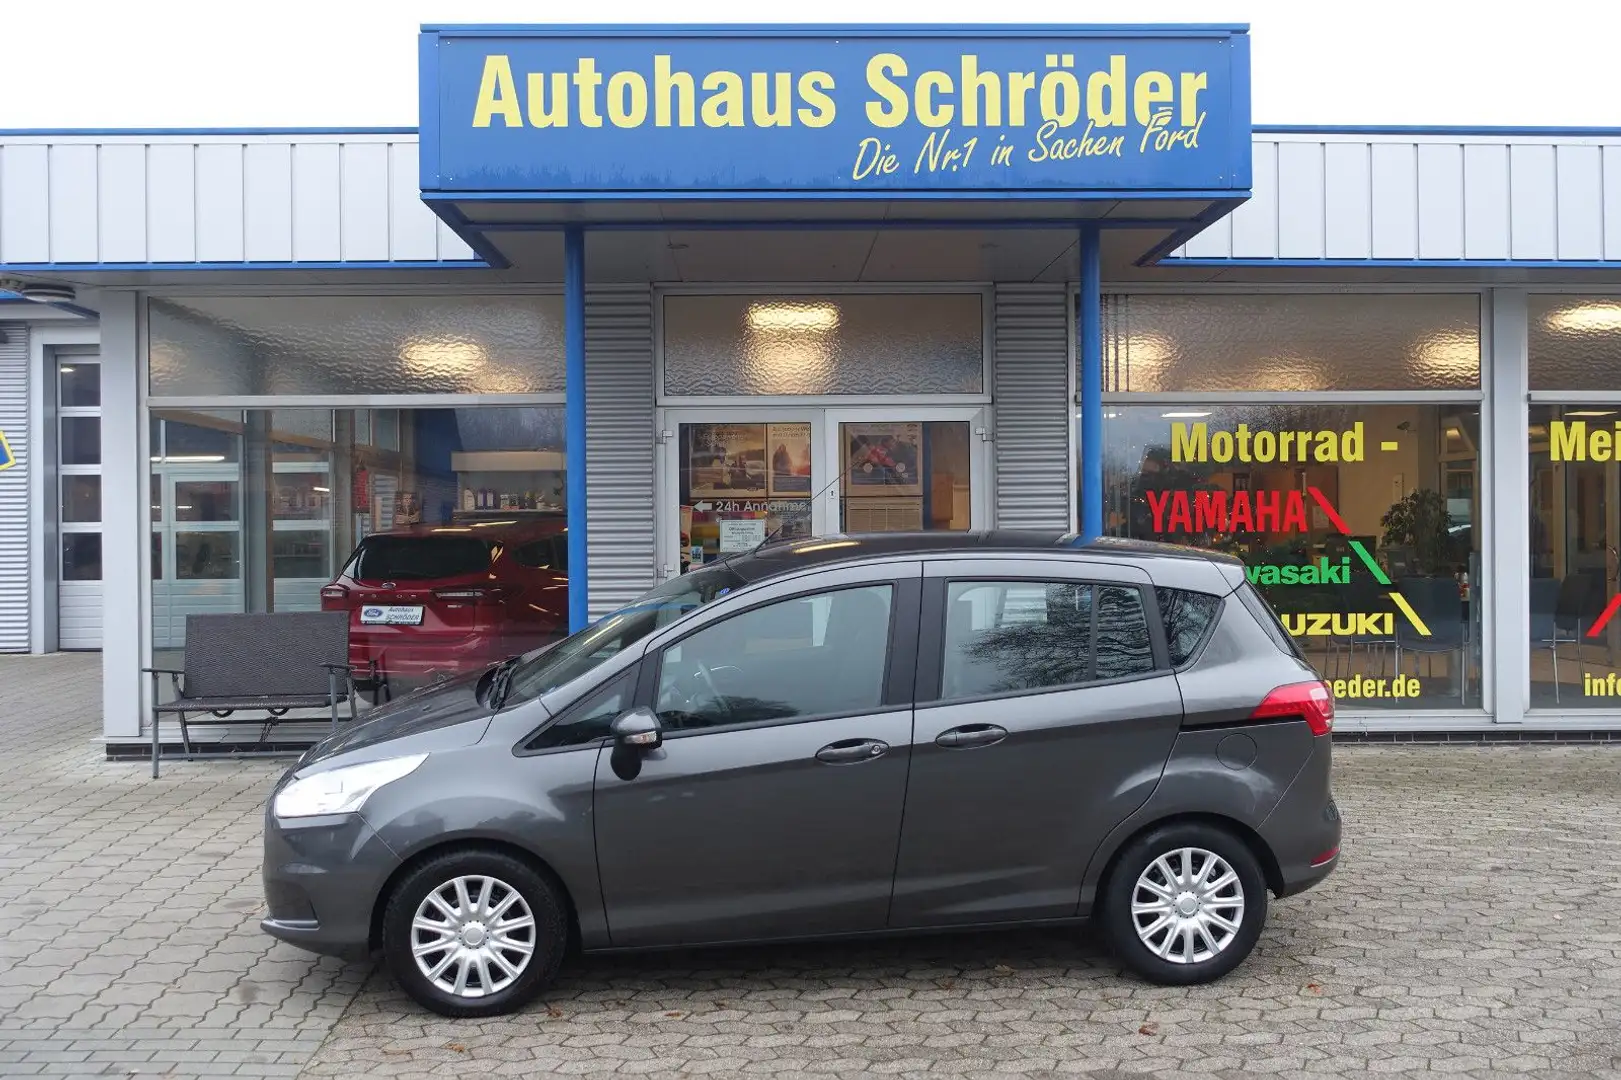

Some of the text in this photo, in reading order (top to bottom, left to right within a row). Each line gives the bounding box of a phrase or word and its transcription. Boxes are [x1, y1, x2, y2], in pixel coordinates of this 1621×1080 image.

[472, 53, 1207, 128] Autohaus Schröder
[852, 107, 1206, 180] Die Nr.1 in Sachen Ford
[1171, 421, 1364, 463] Motorrad
[716, 500, 740, 512] 24h
[1146, 490, 1308, 533] YAMAHA
[1325, 673, 1421, 699] eder.de
